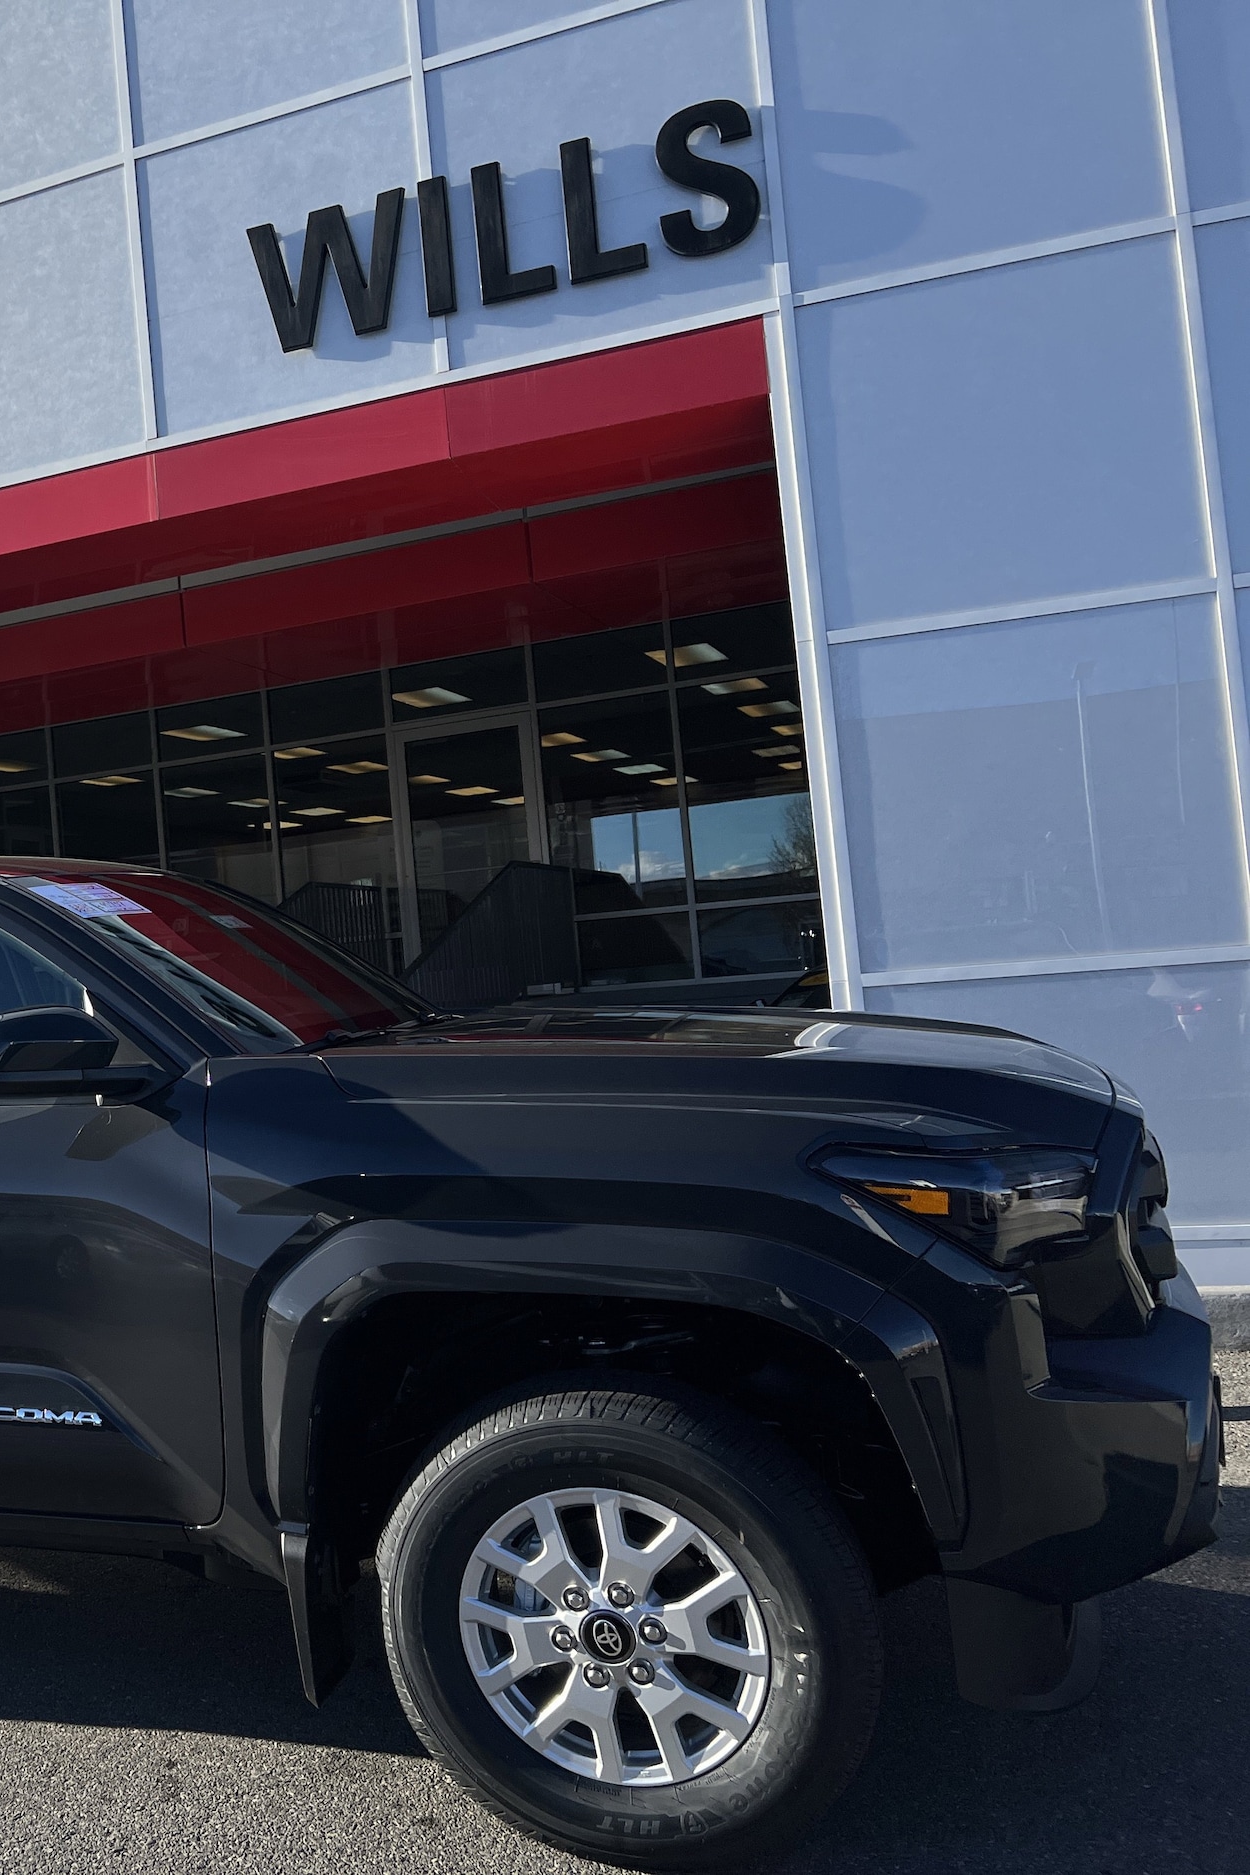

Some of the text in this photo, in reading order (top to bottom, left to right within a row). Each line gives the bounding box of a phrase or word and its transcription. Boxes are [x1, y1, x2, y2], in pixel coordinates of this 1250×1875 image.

[246, 99, 761, 353] WILLS
[553, 1452, 614, 1464] HLT
[596, 1815, 661, 1835] HLT
